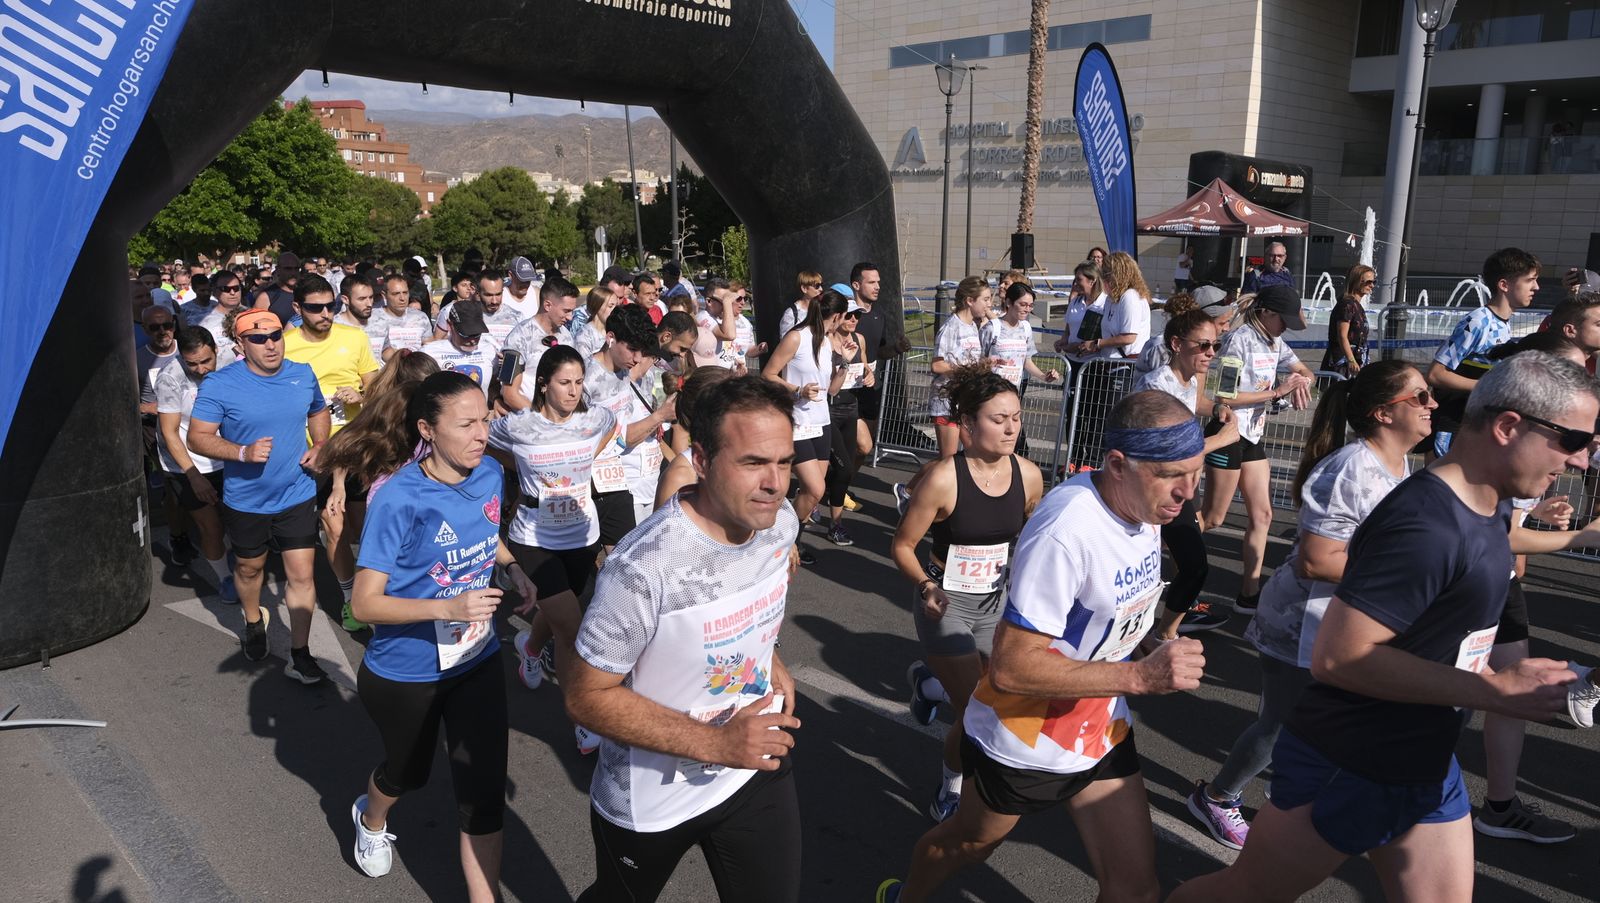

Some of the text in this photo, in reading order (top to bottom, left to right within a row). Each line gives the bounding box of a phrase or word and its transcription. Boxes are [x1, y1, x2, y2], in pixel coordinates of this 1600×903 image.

[670, 3, 731, 27] deportivo
[595, 466, 625, 481] 1038
[547, 496, 586, 513] 1185
[434, 532, 458, 543] ALTEA
